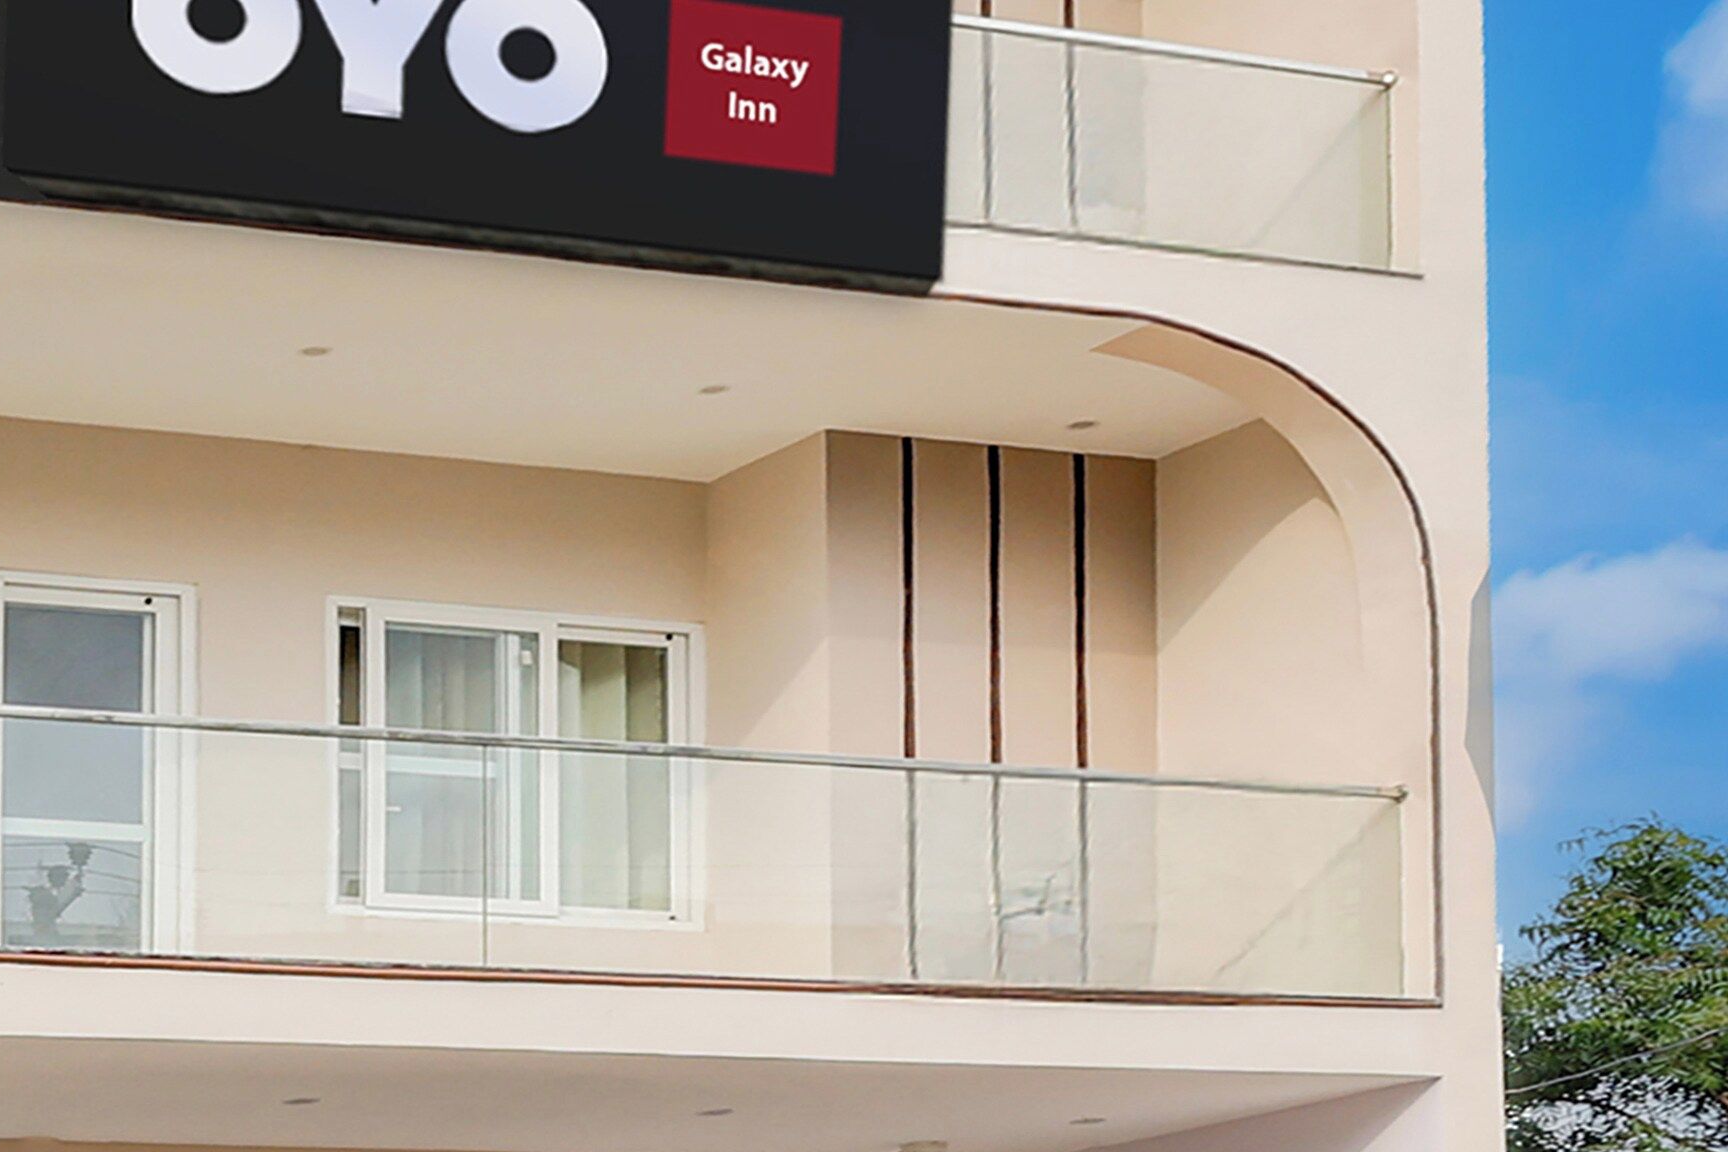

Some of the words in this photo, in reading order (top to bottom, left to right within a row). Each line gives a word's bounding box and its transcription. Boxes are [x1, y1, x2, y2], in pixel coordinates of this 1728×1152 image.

[131, 0, 608, 133] OYO
[700, 42, 809, 89] Galaxy
[727, 91, 777, 124] Inn
